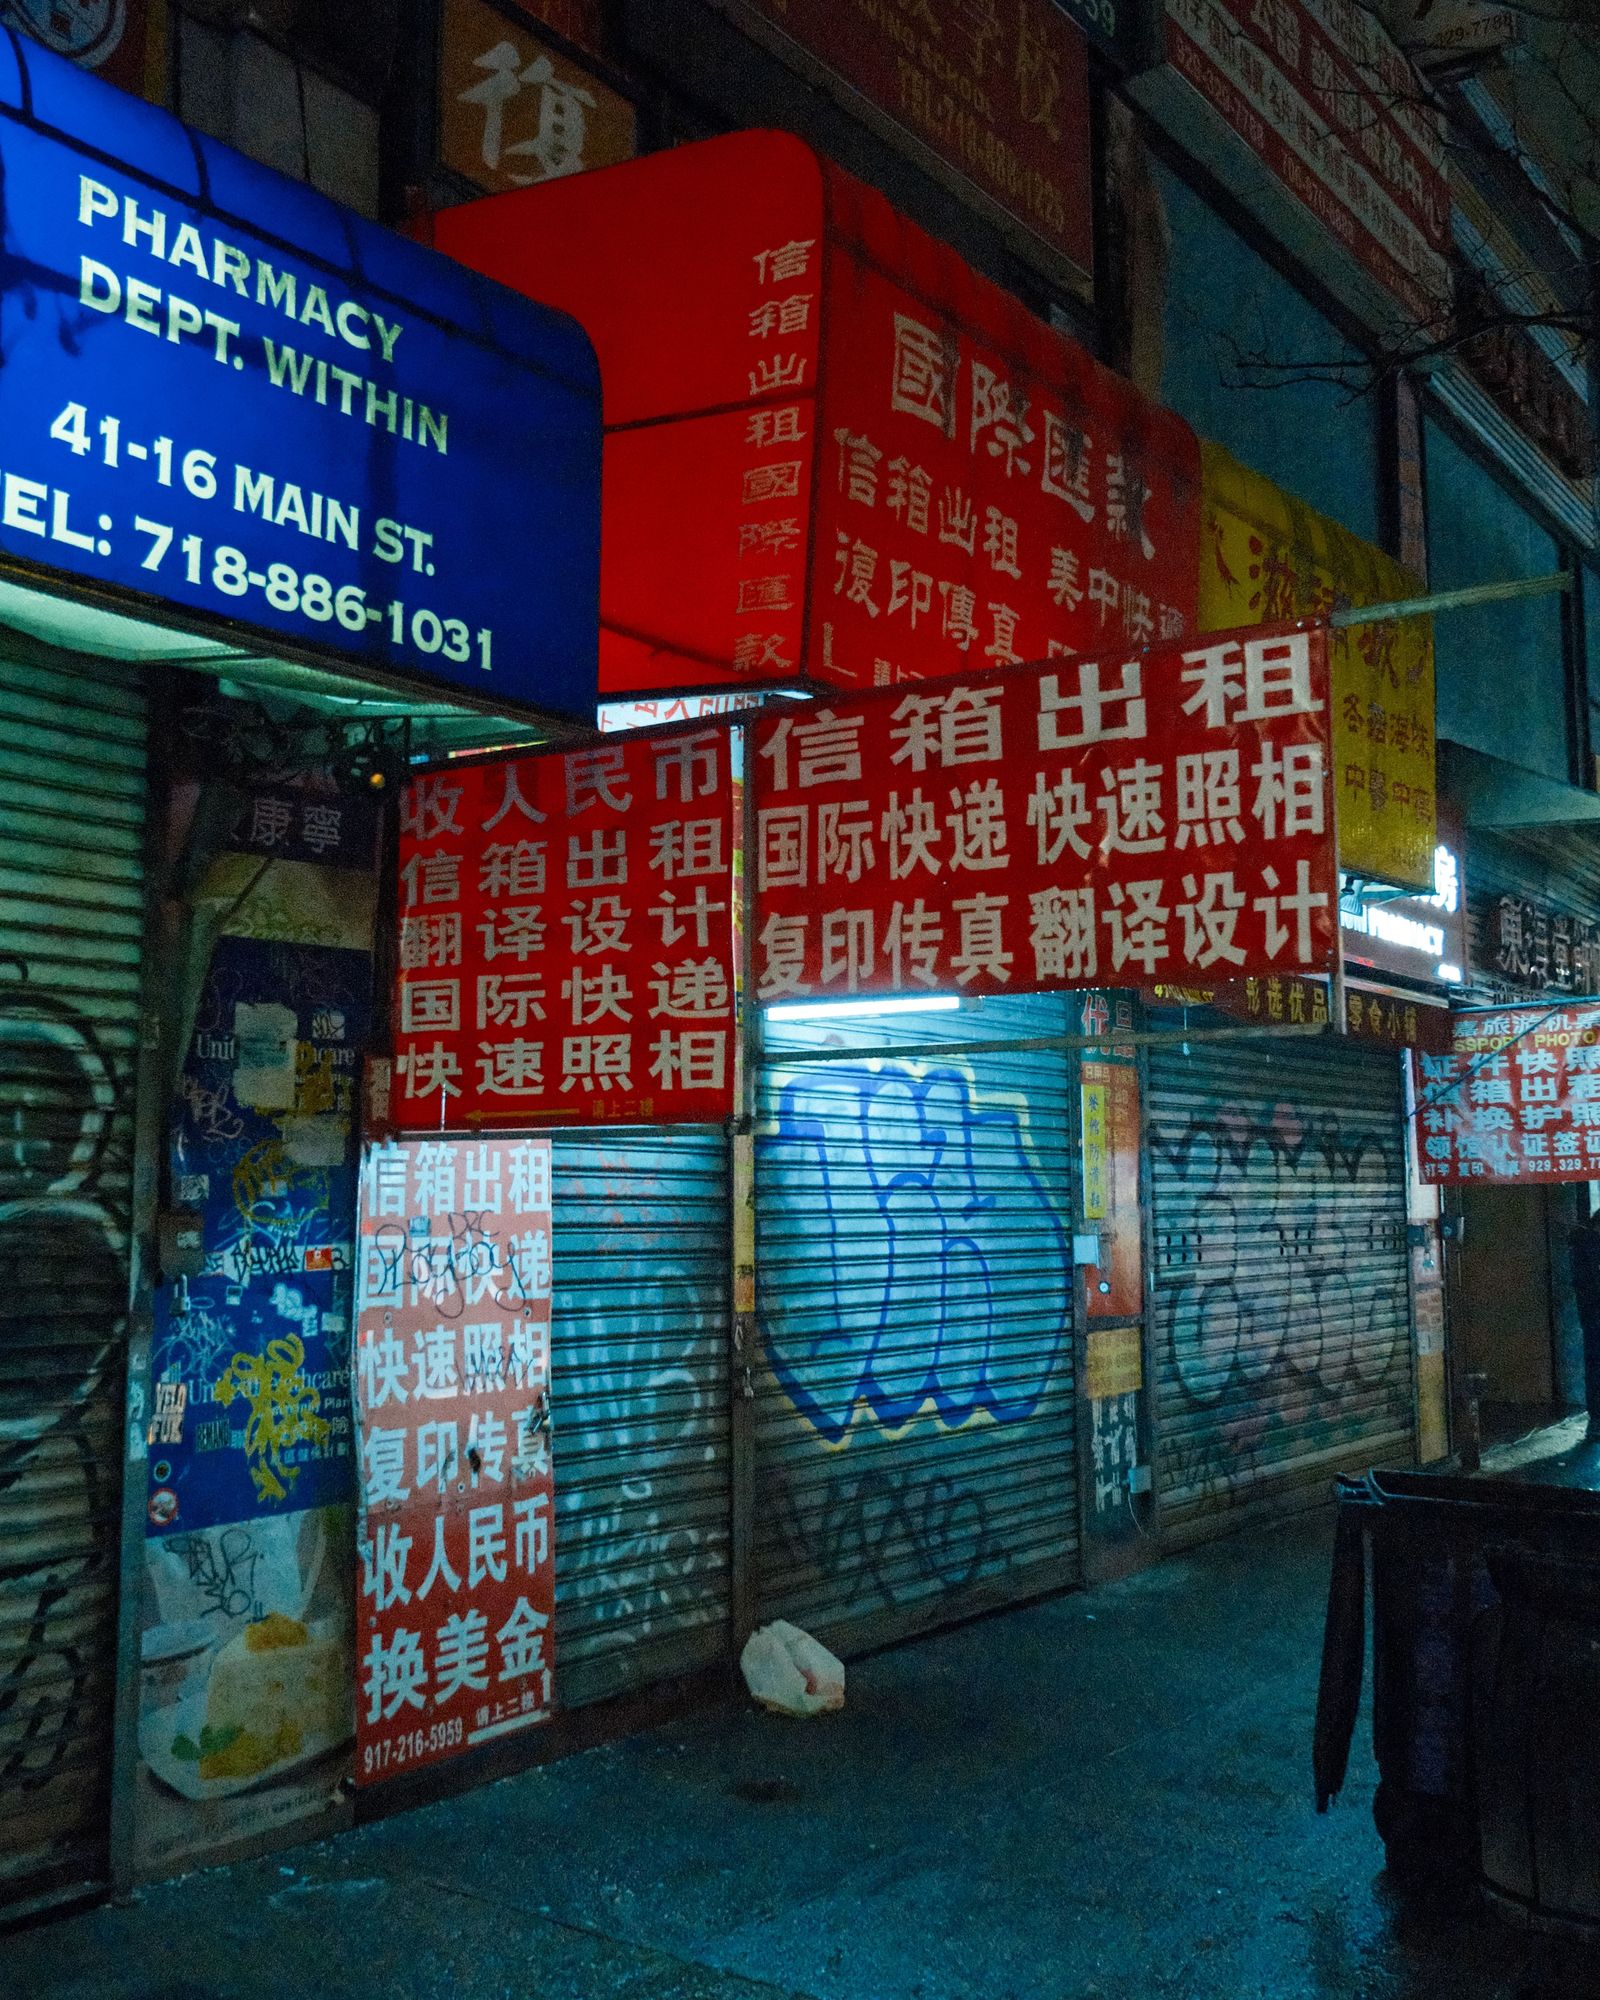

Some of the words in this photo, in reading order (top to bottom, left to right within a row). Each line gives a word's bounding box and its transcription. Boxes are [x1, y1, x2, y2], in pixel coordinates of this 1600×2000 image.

[78, 174, 404, 363] PHARMACY
[79, 255, 244, 371] DEPT.
[261, 335, 450, 456] WITHIN
[50, 401, 218, 500] 41-16
[234, 463, 360, 552] MAIN
[373, 518, 436, 577] ST.
[0, 467, 113, 556] EL:
[135, 515, 493, 671] 718-886-1031
[758, 632, 1326, 792] 信箱出租
[400, 729, 723, 842] 收人民币
[757, 777, 1011, 894] 国际快递
[1025, 741, 1324, 866] 快速照相
[400, 817, 729, 908] 信箱出租
[400, 886, 727, 970] 翻译设计
[756, 891, 1016, 1002] 复印传真
[1028, 858, 1330, 982] 翻译设计
[401, 956, 731, 1034] 国际快递
[1454, 1035, 1522, 1052] SSPORT
[1534, 1030, 1597, 1048] PHOTO
[397, 1029, 728, 1100] 快速照相
[362, 1140, 550, 1217] 信箱出租
[359, 1228, 550, 1313] 国际快递
[358, 1319, 550, 1409] 快速照相
[362, 1404, 550, 1507] 复印传真
[361, 1491, 549, 1613] 收人民币
[362, 1595, 550, 1725] 换美金
